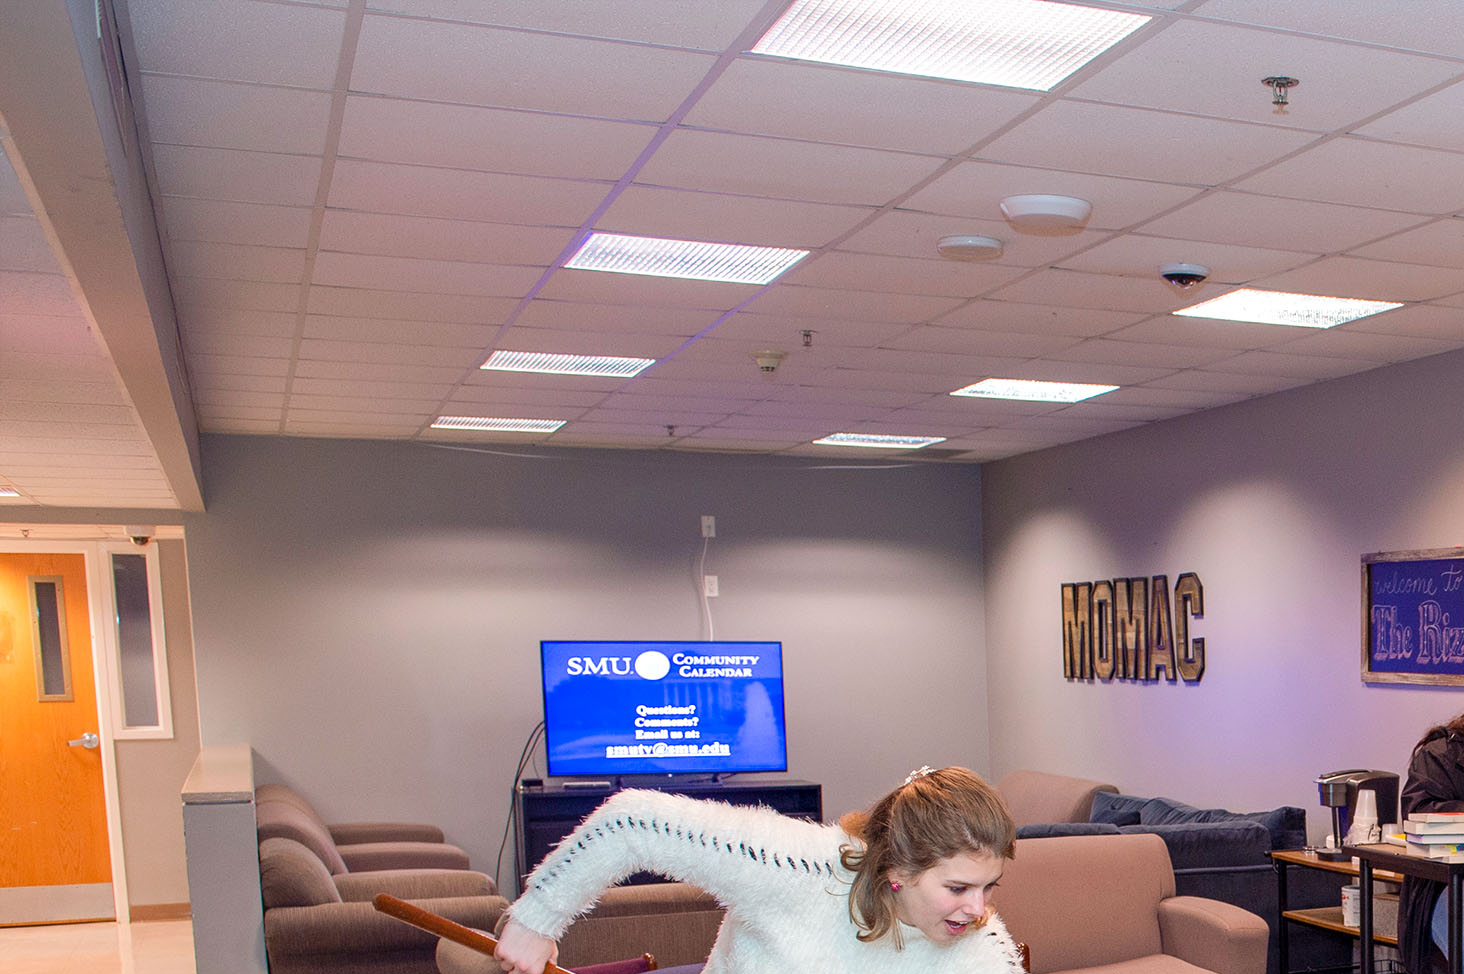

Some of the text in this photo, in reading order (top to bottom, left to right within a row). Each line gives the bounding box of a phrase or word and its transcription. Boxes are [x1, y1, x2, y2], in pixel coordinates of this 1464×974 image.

[1061, 572, 1205, 683] MOMAC
[1371, 604, 1414, 661] The
[634, 717, 699, 727] Comments?
[636, 704, 696, 717] Questions?
